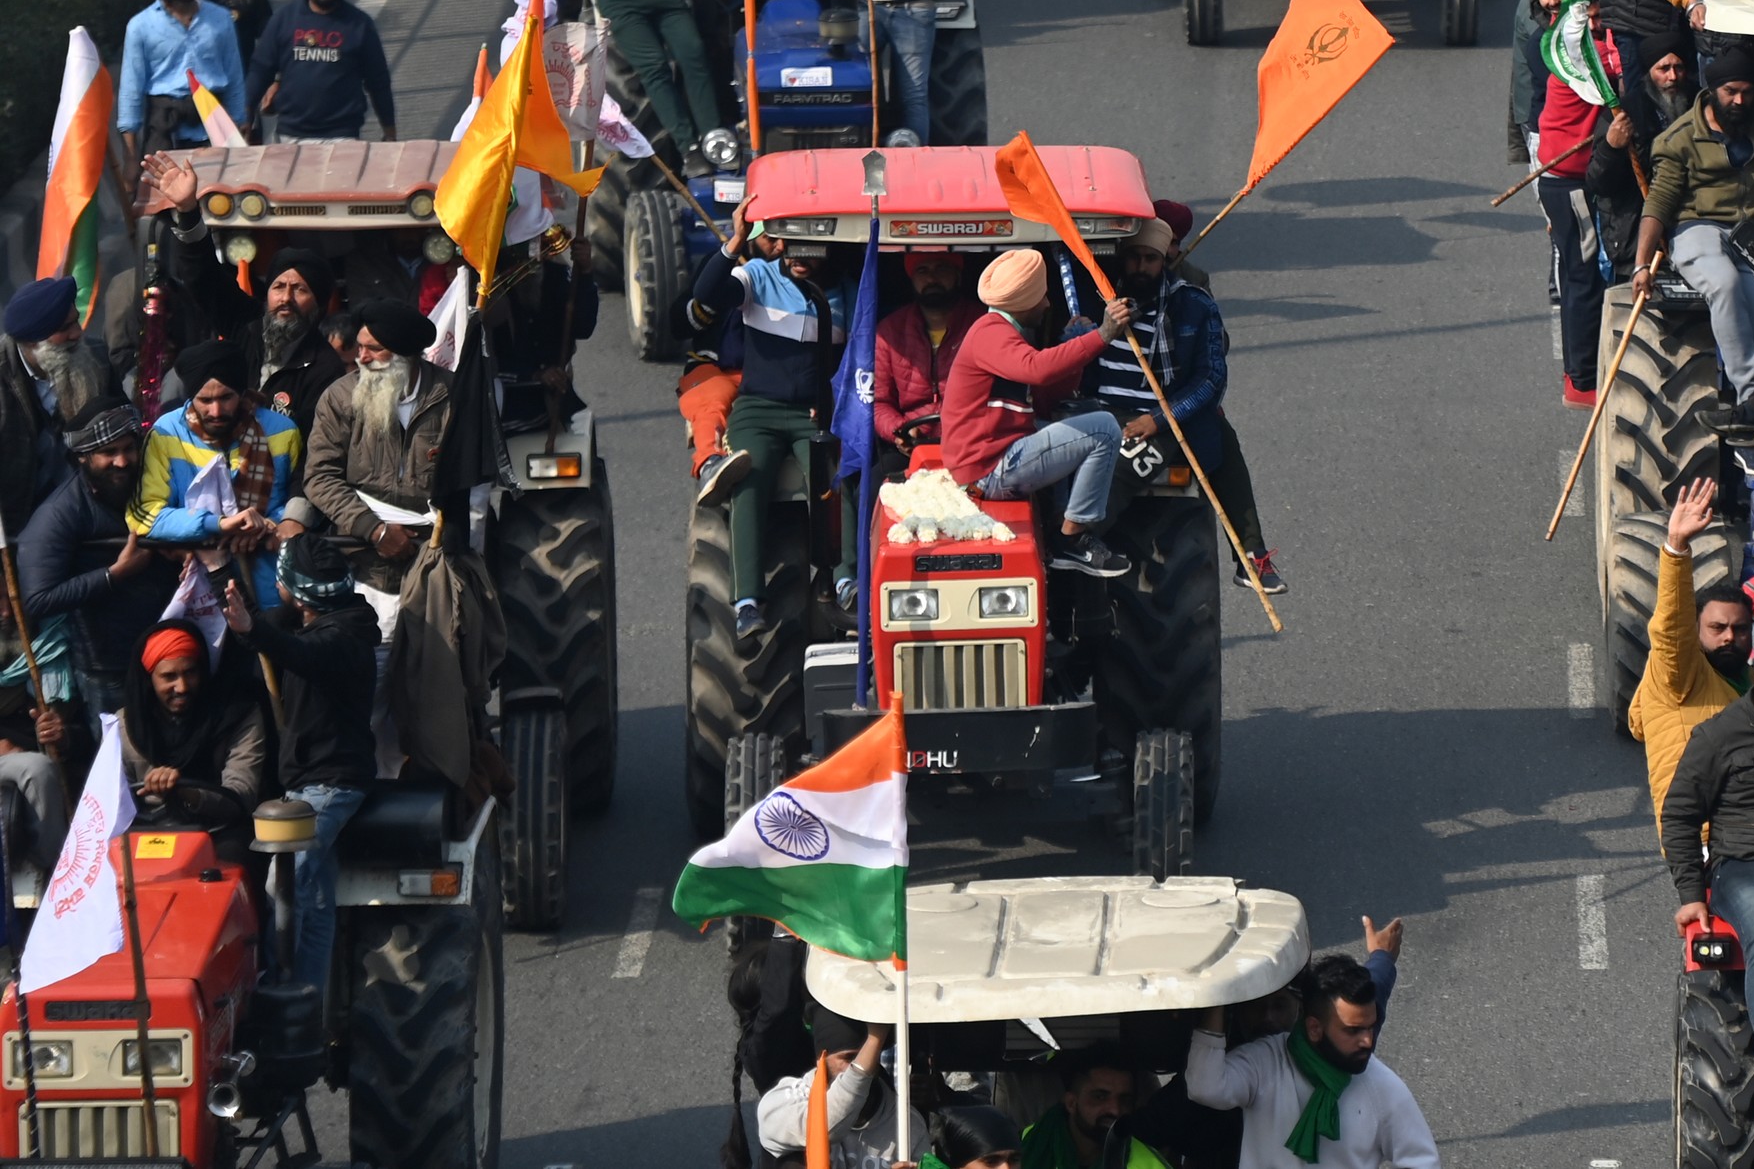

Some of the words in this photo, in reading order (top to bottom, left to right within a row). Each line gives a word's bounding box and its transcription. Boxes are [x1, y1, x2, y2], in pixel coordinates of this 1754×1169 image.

[294, 29, 343, 48] POLO
[293, 47, 339, 62] TENNIS
[774, 93, 853, 104] FARMTRAC
[52, 1003, 147, 1019] SWARA
